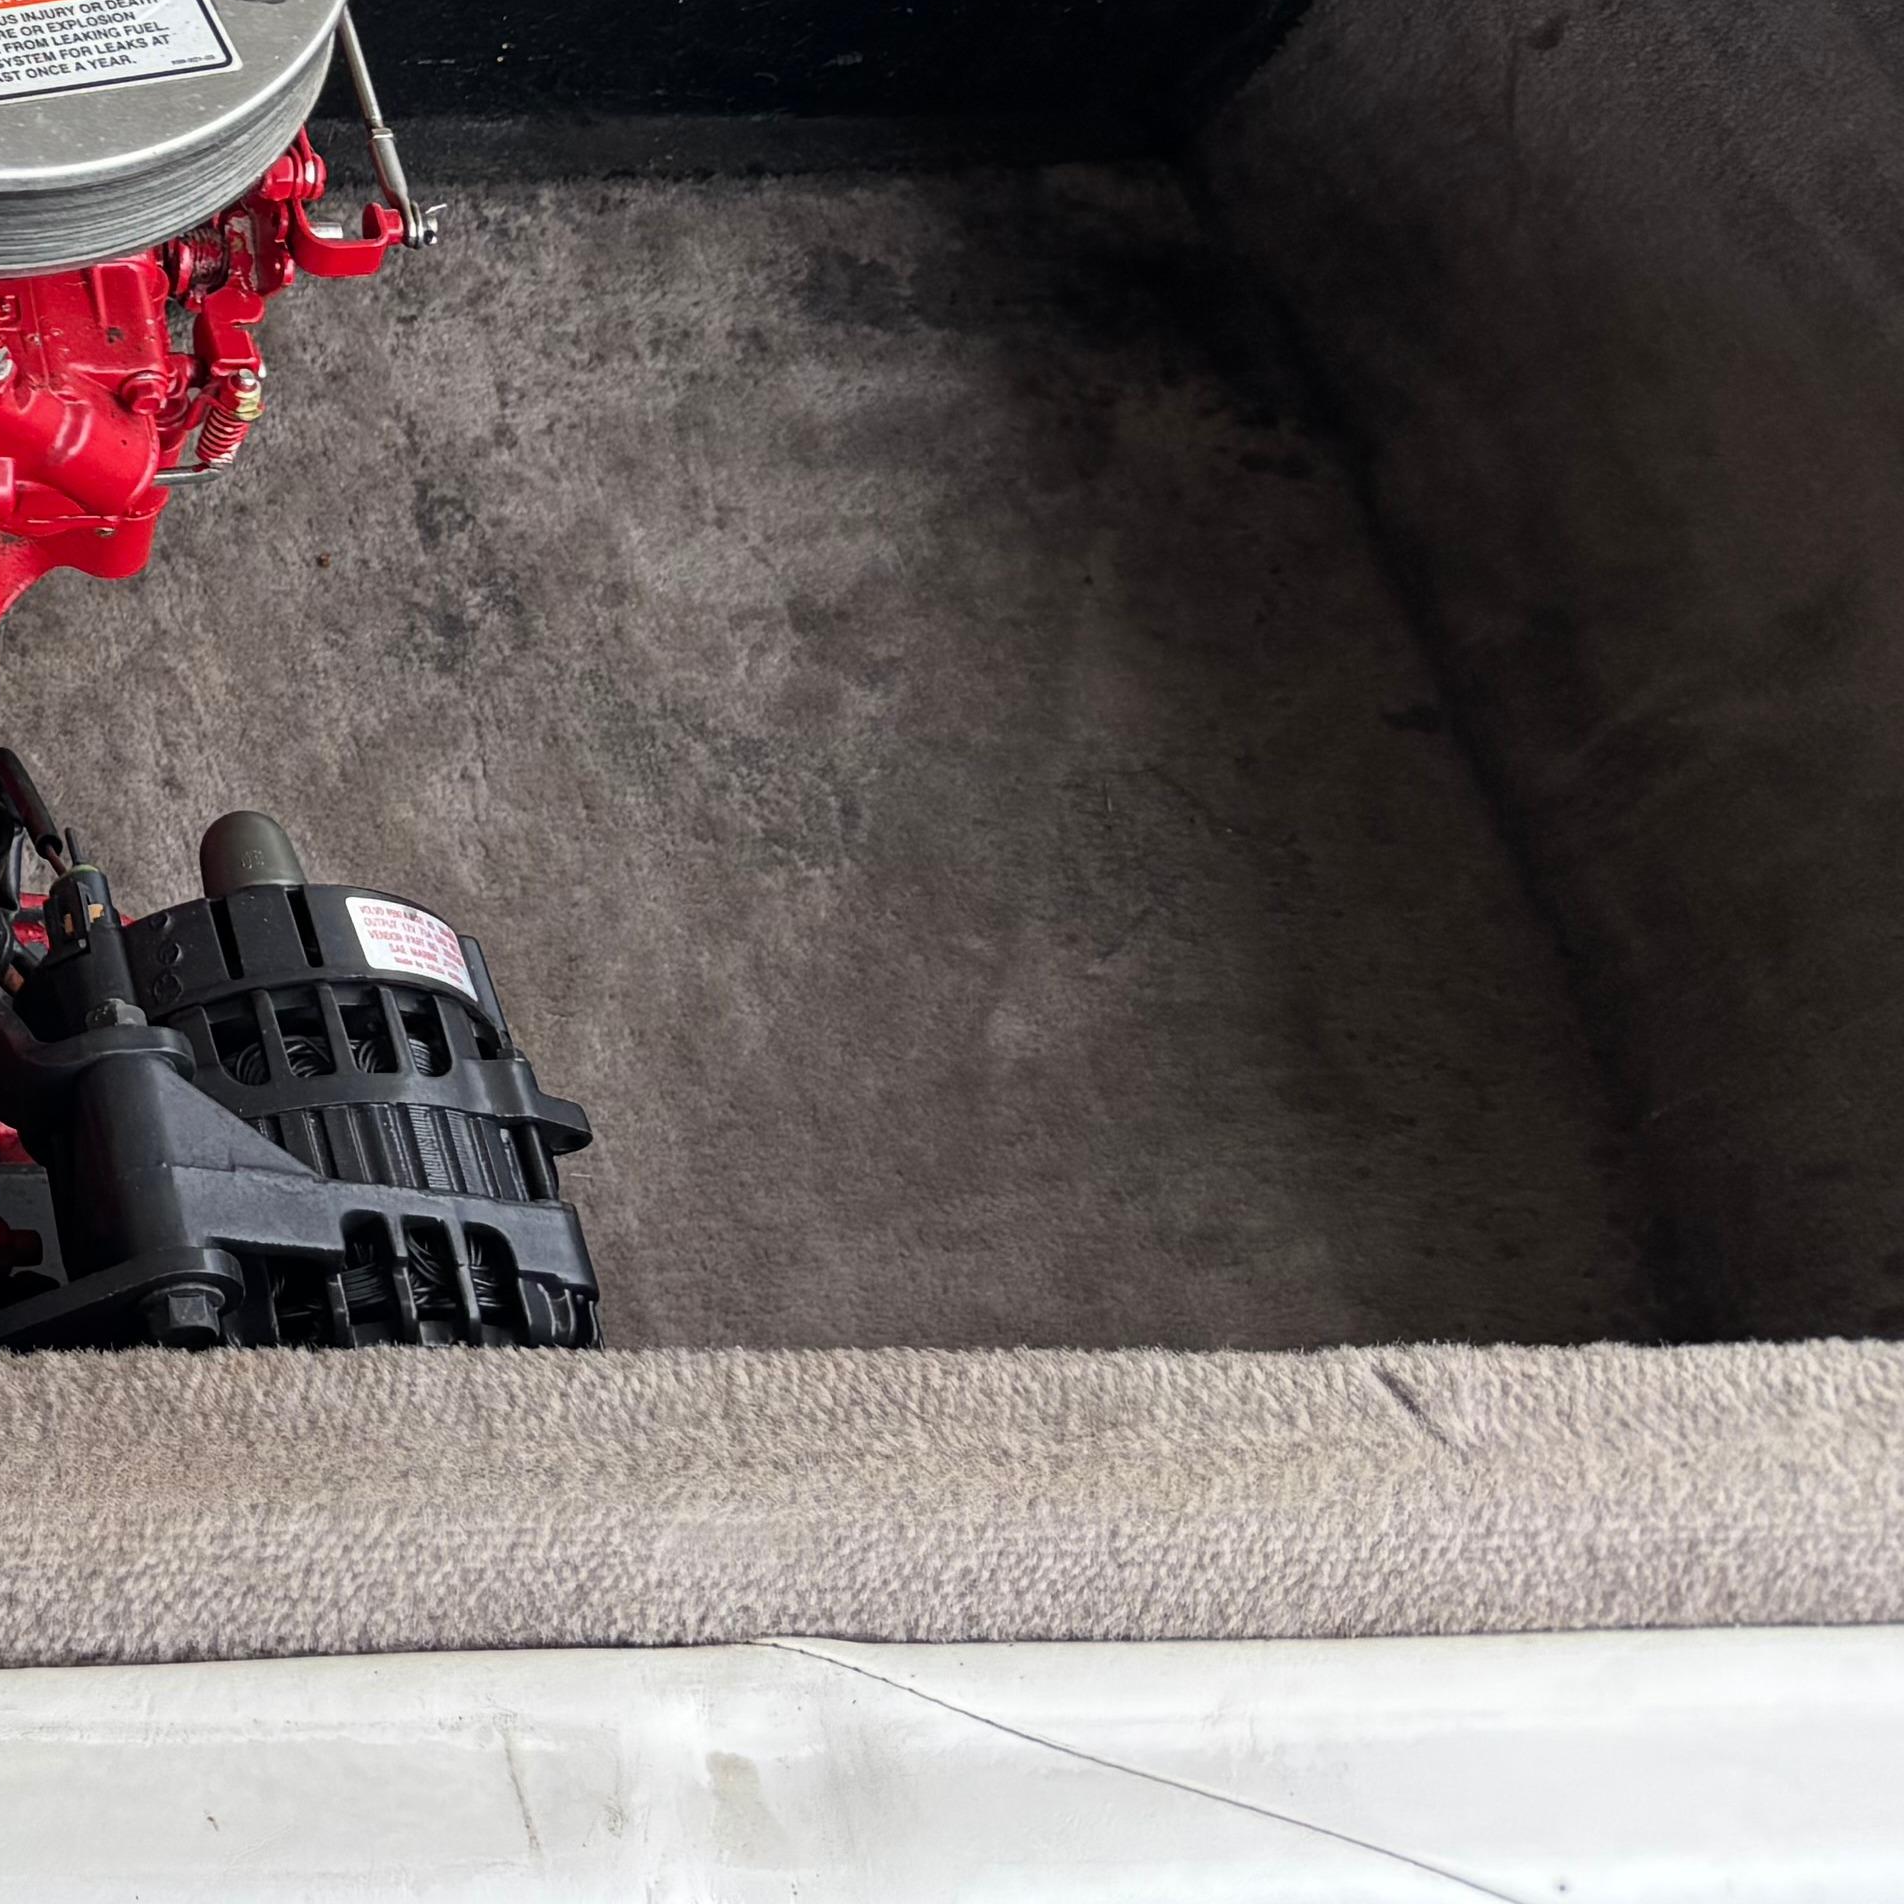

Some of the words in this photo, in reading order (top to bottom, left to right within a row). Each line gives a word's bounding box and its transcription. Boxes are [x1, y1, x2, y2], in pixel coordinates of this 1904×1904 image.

[21, 6, 74, 24] INJURY
[79, 1, 102, 16] OR
[22, 24, 42, 37] OR
[46, 11, 136, 34] EXPLOSION
[4, 38, 49, 54] FROM
[53, 26, 121, 47] LEAKING
[124, 21, 170, 37] FUEL.
[60, 45, 91, 60] FOR
[95, 37, 149, 56] LEAKS
[153, 33, 170, 47] AT
[26, 64, 71, 78] ONCE
[75, 60, 88, 72] A
[89, 54, 137, 70] YEAR.
